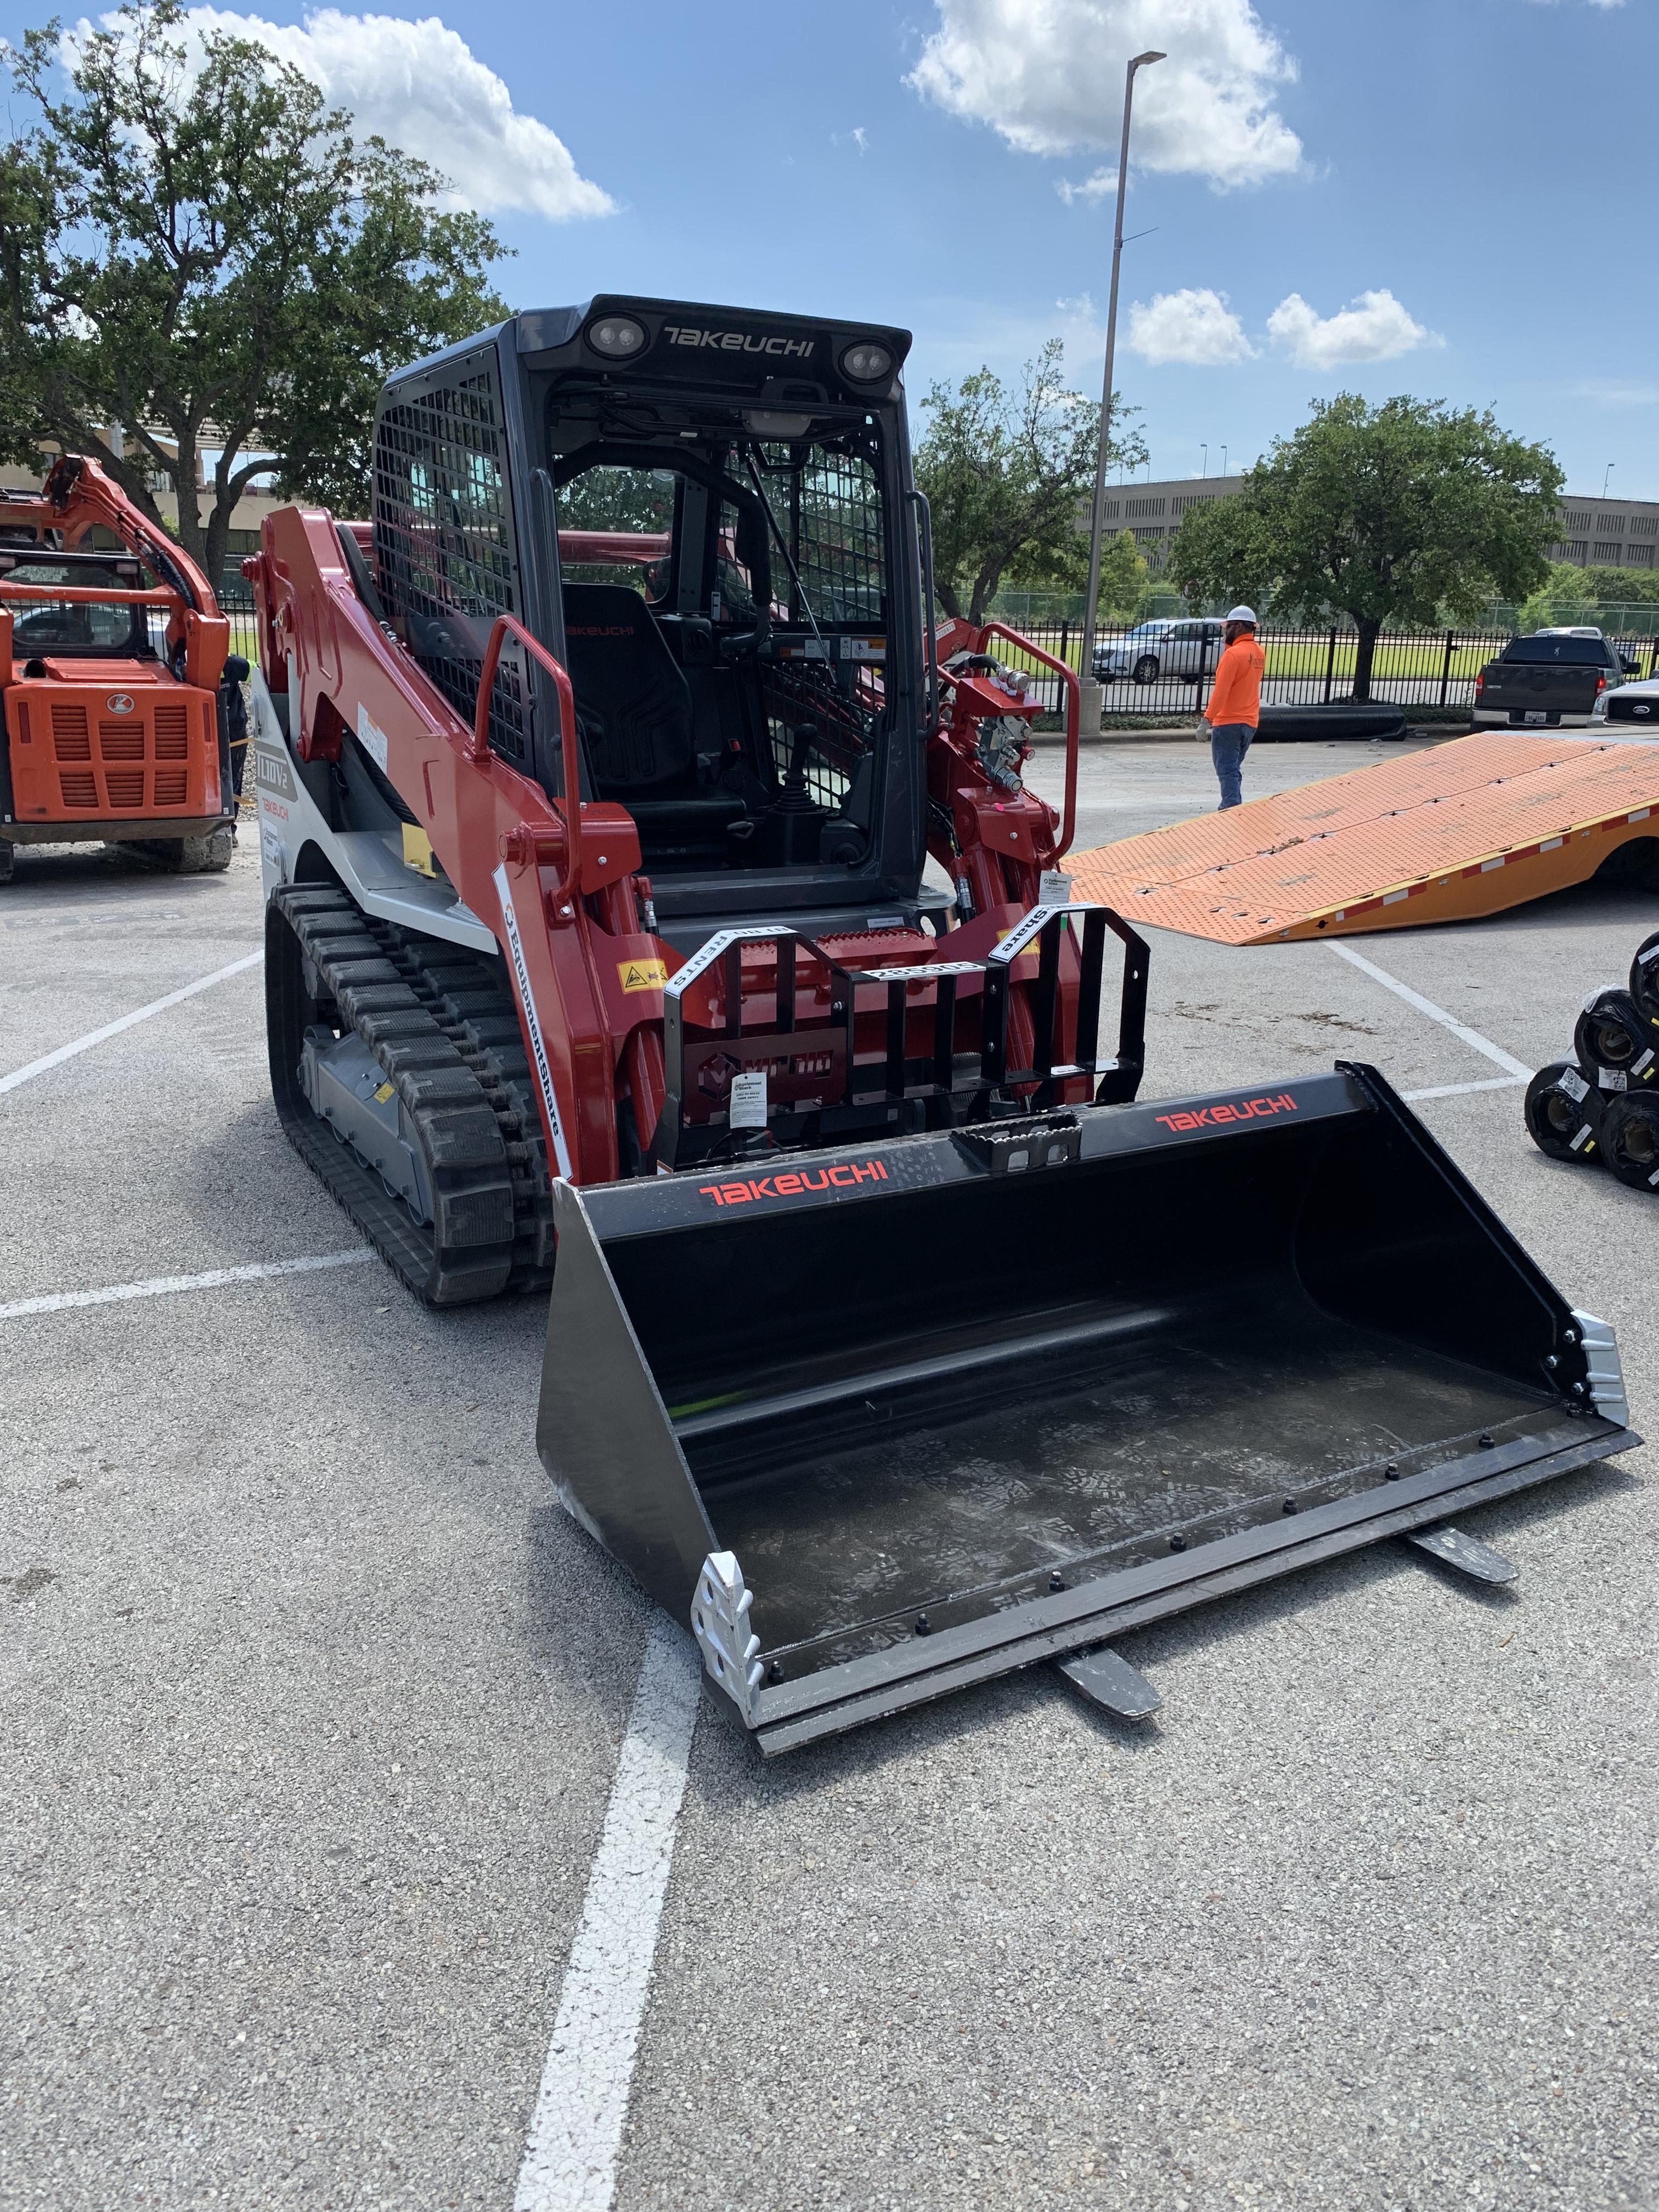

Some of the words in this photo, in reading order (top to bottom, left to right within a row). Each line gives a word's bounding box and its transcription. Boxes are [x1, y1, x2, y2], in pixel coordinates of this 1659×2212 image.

[664, 326, 815, 357] TAKEUCHI
[566, 627, 635, 636] AKEUCHI
[262, 797, 290, 822] TAKEUCHI
[870, 962, 979, 978] 285905
[510, 932, 560, 1138] EquipmentShare
[1154, 1093, 1299, 1132] TAKEUCHI
[699, 1160, 889, 1206] TAKEUCHI
